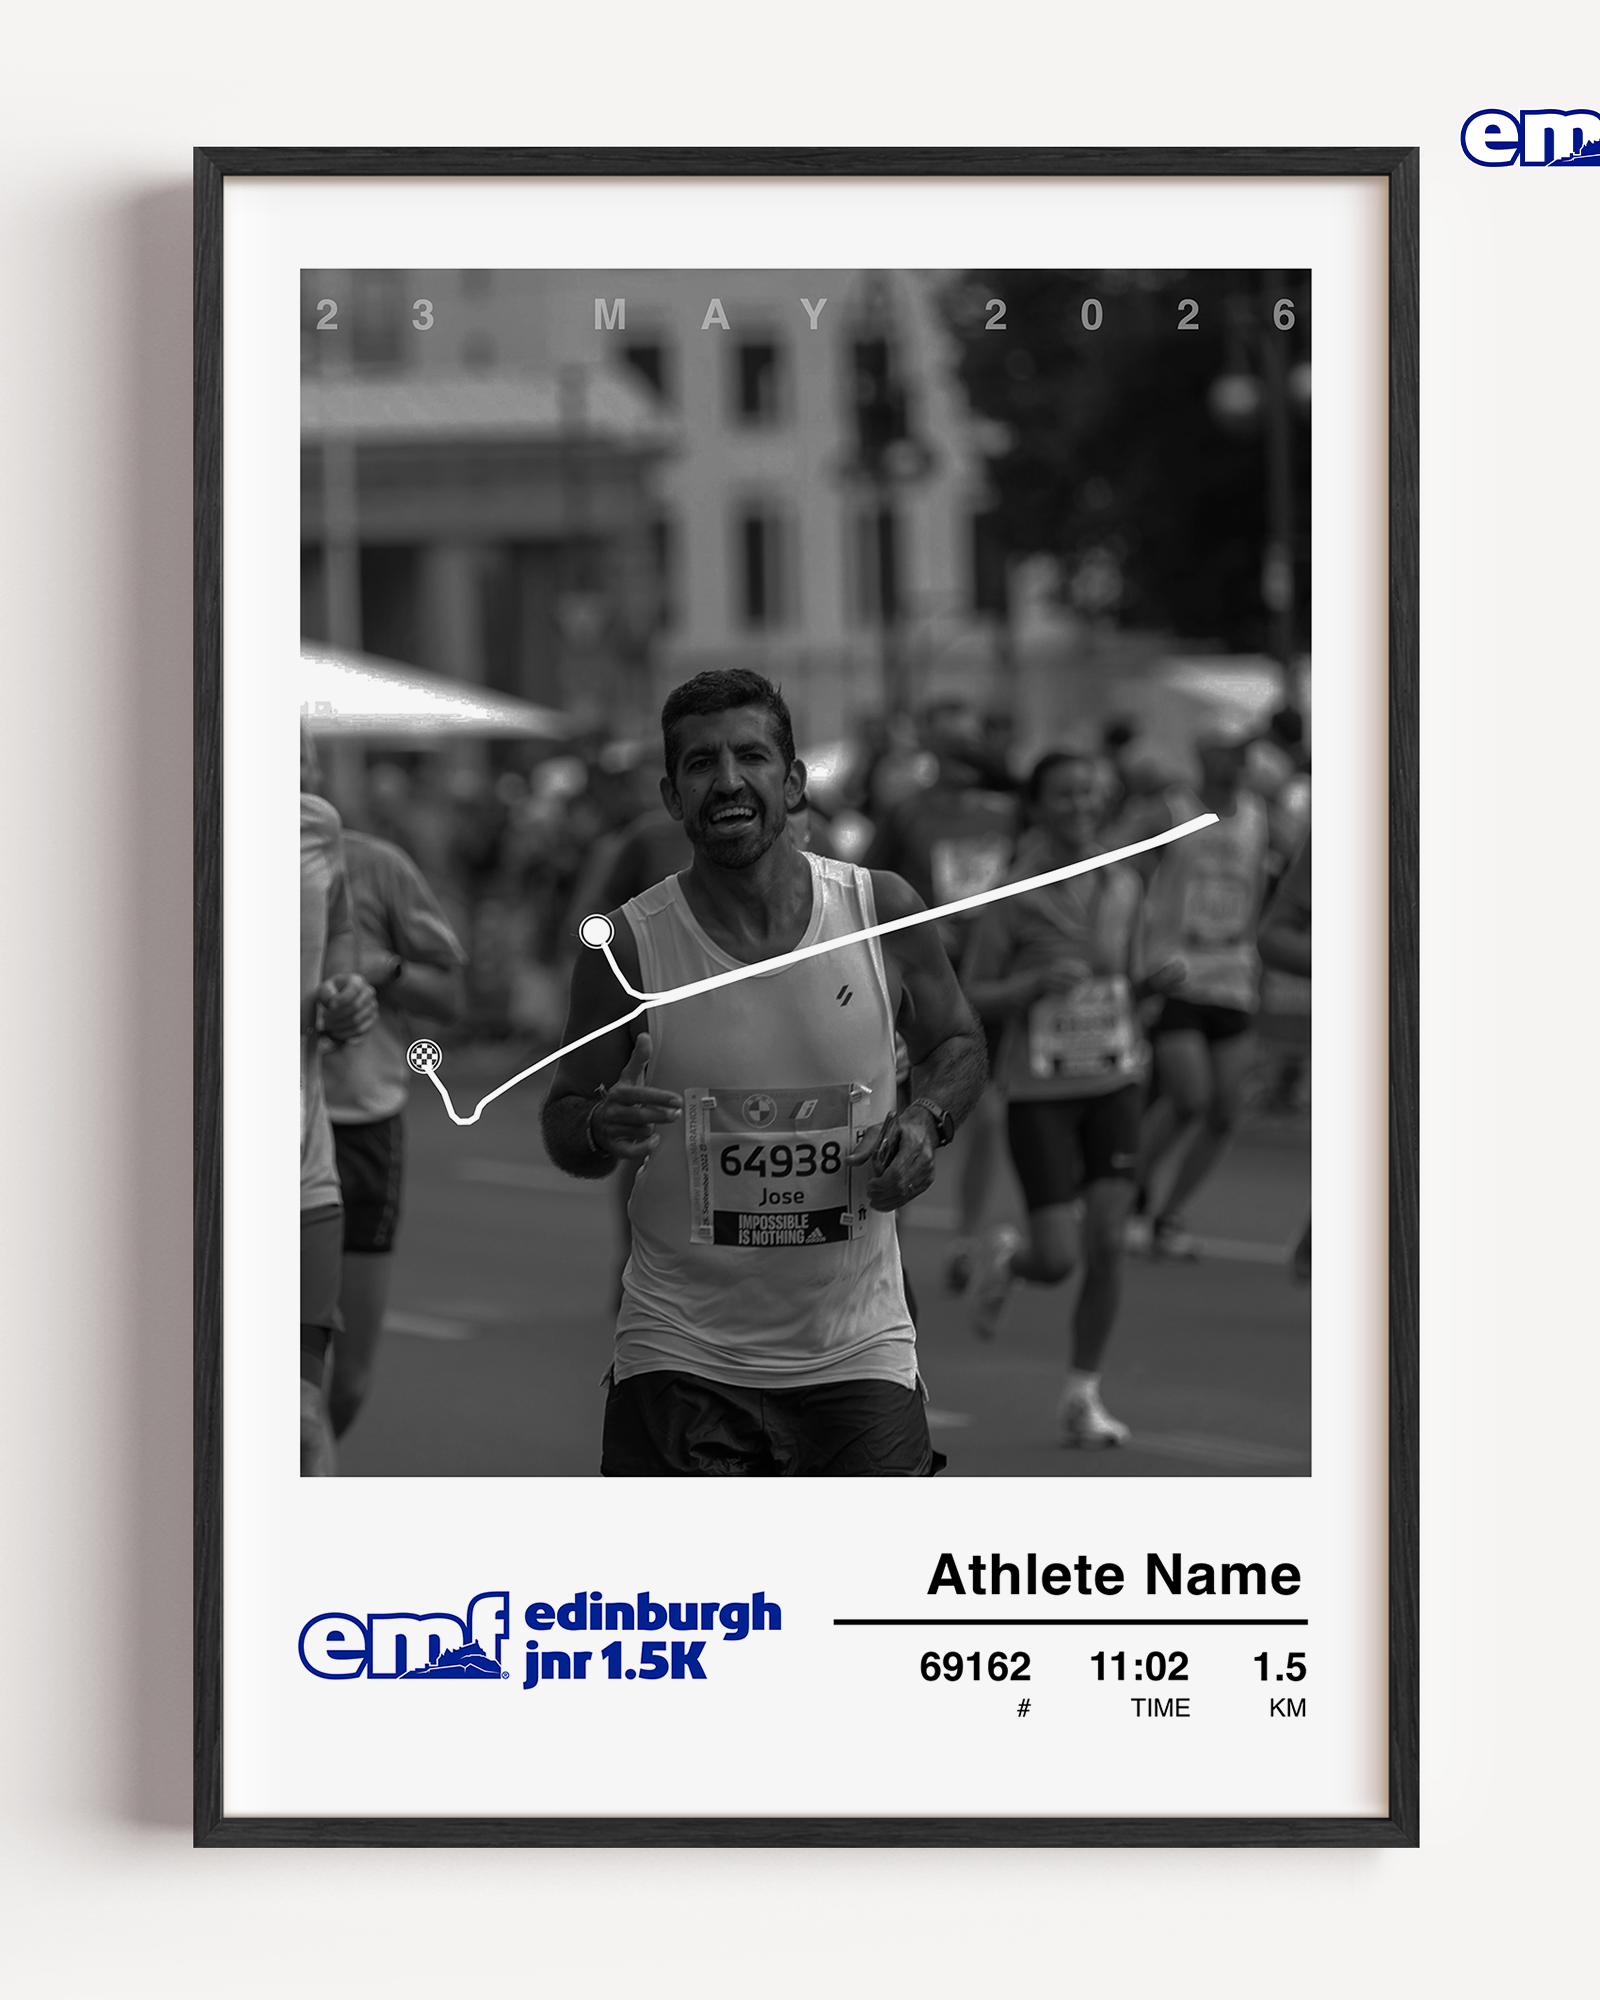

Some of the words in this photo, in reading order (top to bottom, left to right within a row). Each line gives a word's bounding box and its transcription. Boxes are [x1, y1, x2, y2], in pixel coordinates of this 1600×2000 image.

[316, 298, 434, 331] 23
[594, 298, 827, 330] MAY
[985, 298, 1296, 331] 2026
[720, 1141, 842, 1178] 64938
[758, 1188, 805, 1206] Jose
[738, 1213, 809, 1230] IMPOSSIBLE
[738, 1229, 750, 1245] IS
[752, 1229, 805, 1245] NOTHING
[927, 1553, 1125, 1595] Athlete
[1146, 1553, 1301, 1595] Name
[524, 1591, 782, 1641] edinburgh
[298, 1591, 509, 1680] emf
[523, 1640, 593, 1690] jnr
[601, 1641, 708, 1680] 1.5K
[920, 1651, 1031, 1681] 69162
[1090, 1651, 1189, 1681] 11:02
[1253, 1652, 1307, 1681] 1.5
[1130, 1698, 1191, 1718] TIME
[1270, 1698, 1306, 1718] KM
